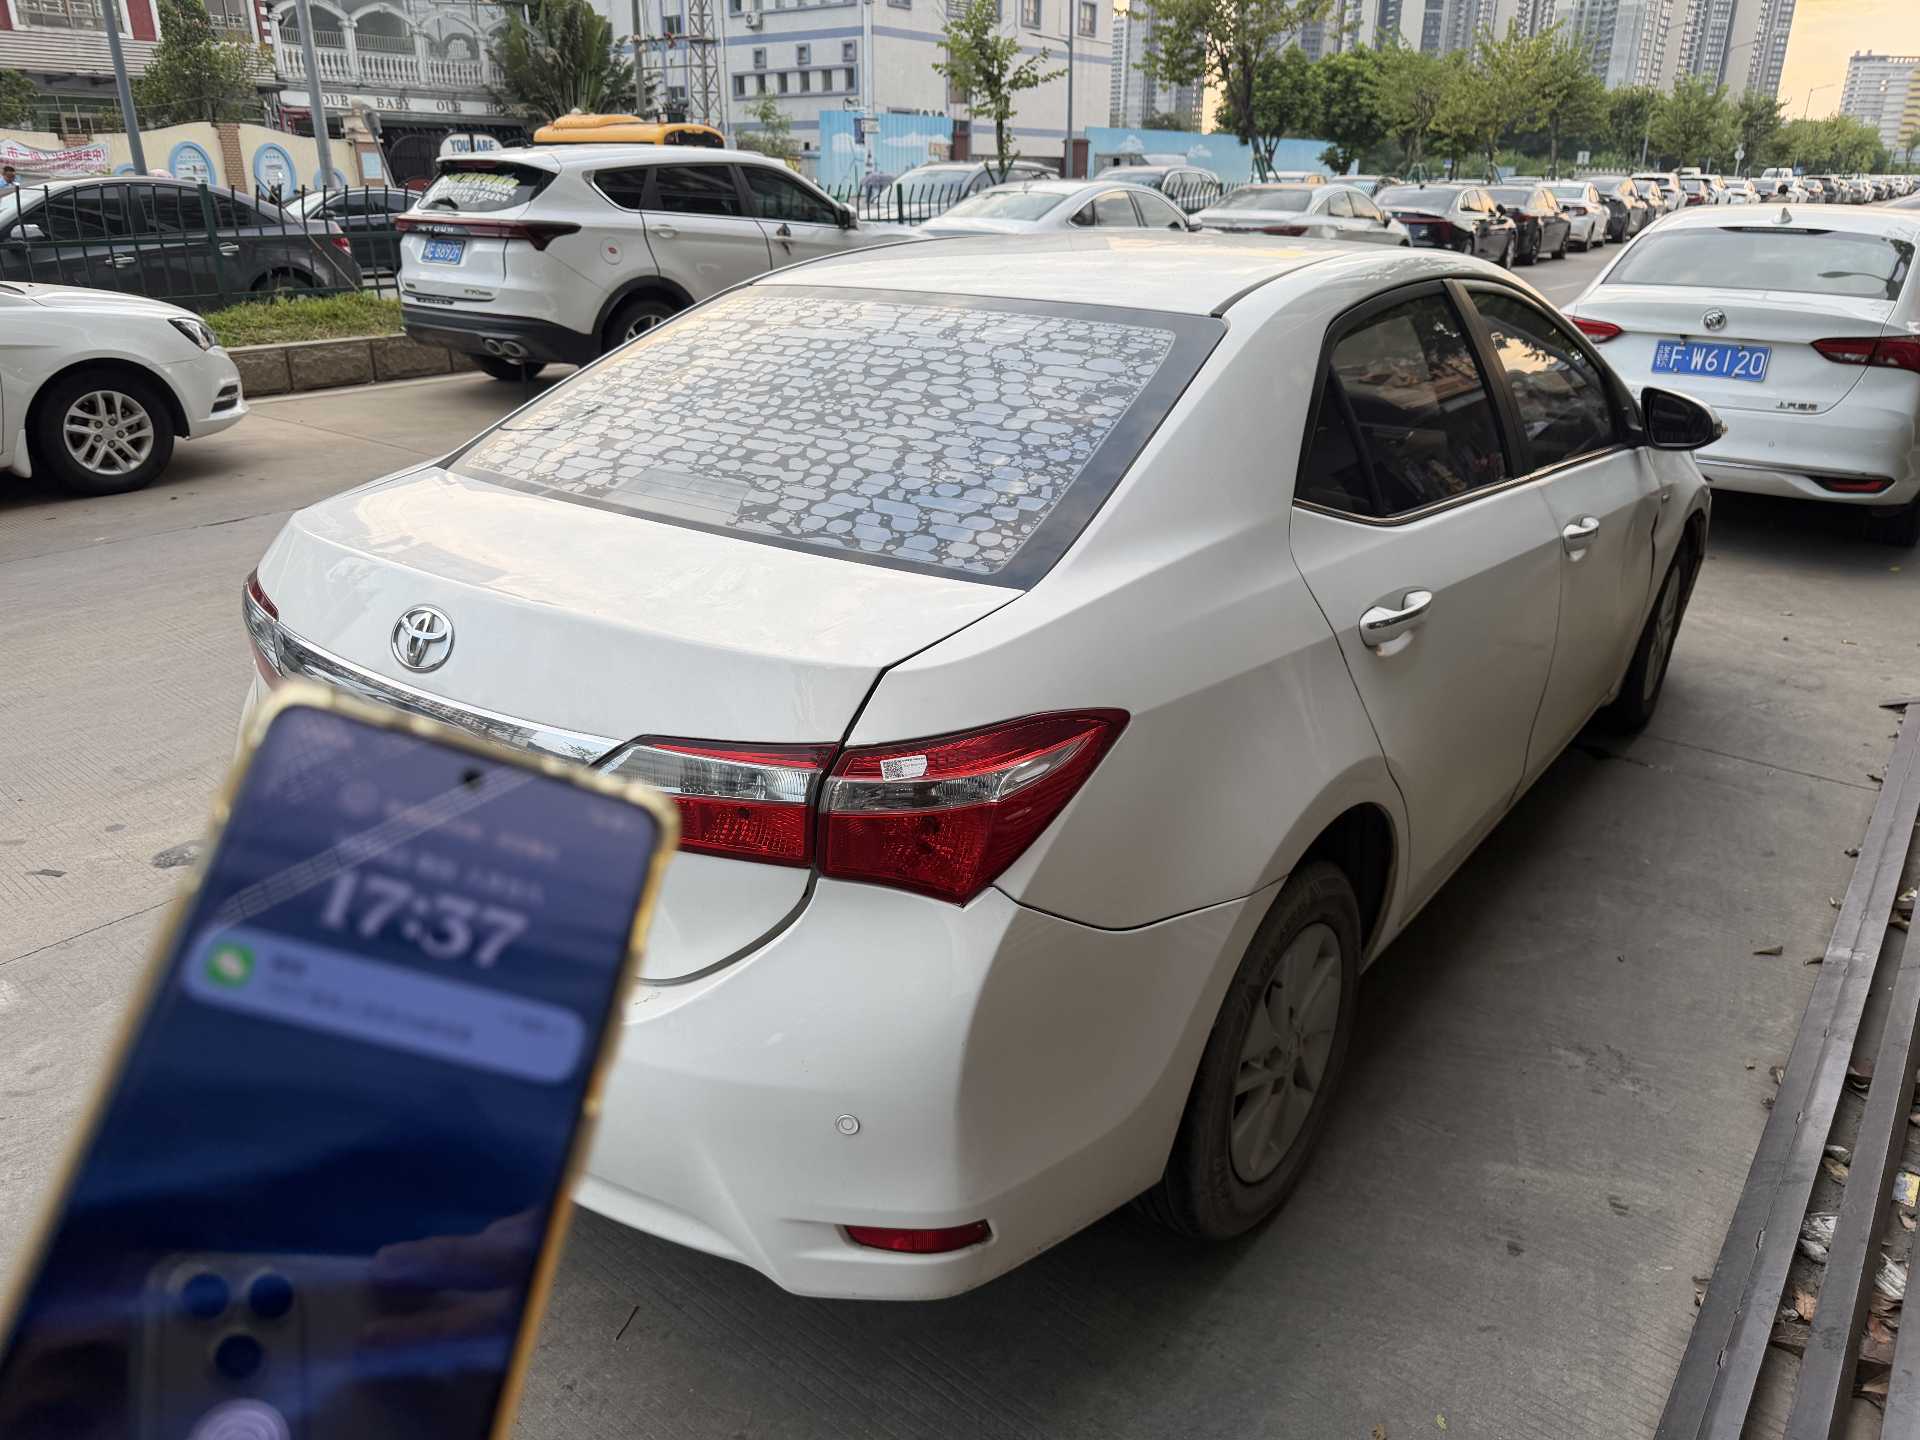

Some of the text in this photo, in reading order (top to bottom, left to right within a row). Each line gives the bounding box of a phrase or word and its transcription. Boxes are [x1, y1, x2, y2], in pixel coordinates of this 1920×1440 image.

[376, 96, 411, 110] BABY
[436, 99, 462, 113] OUR
[450, 139, 494, 152] YOU ARE
[320, 868, 530, 968] 17:37
